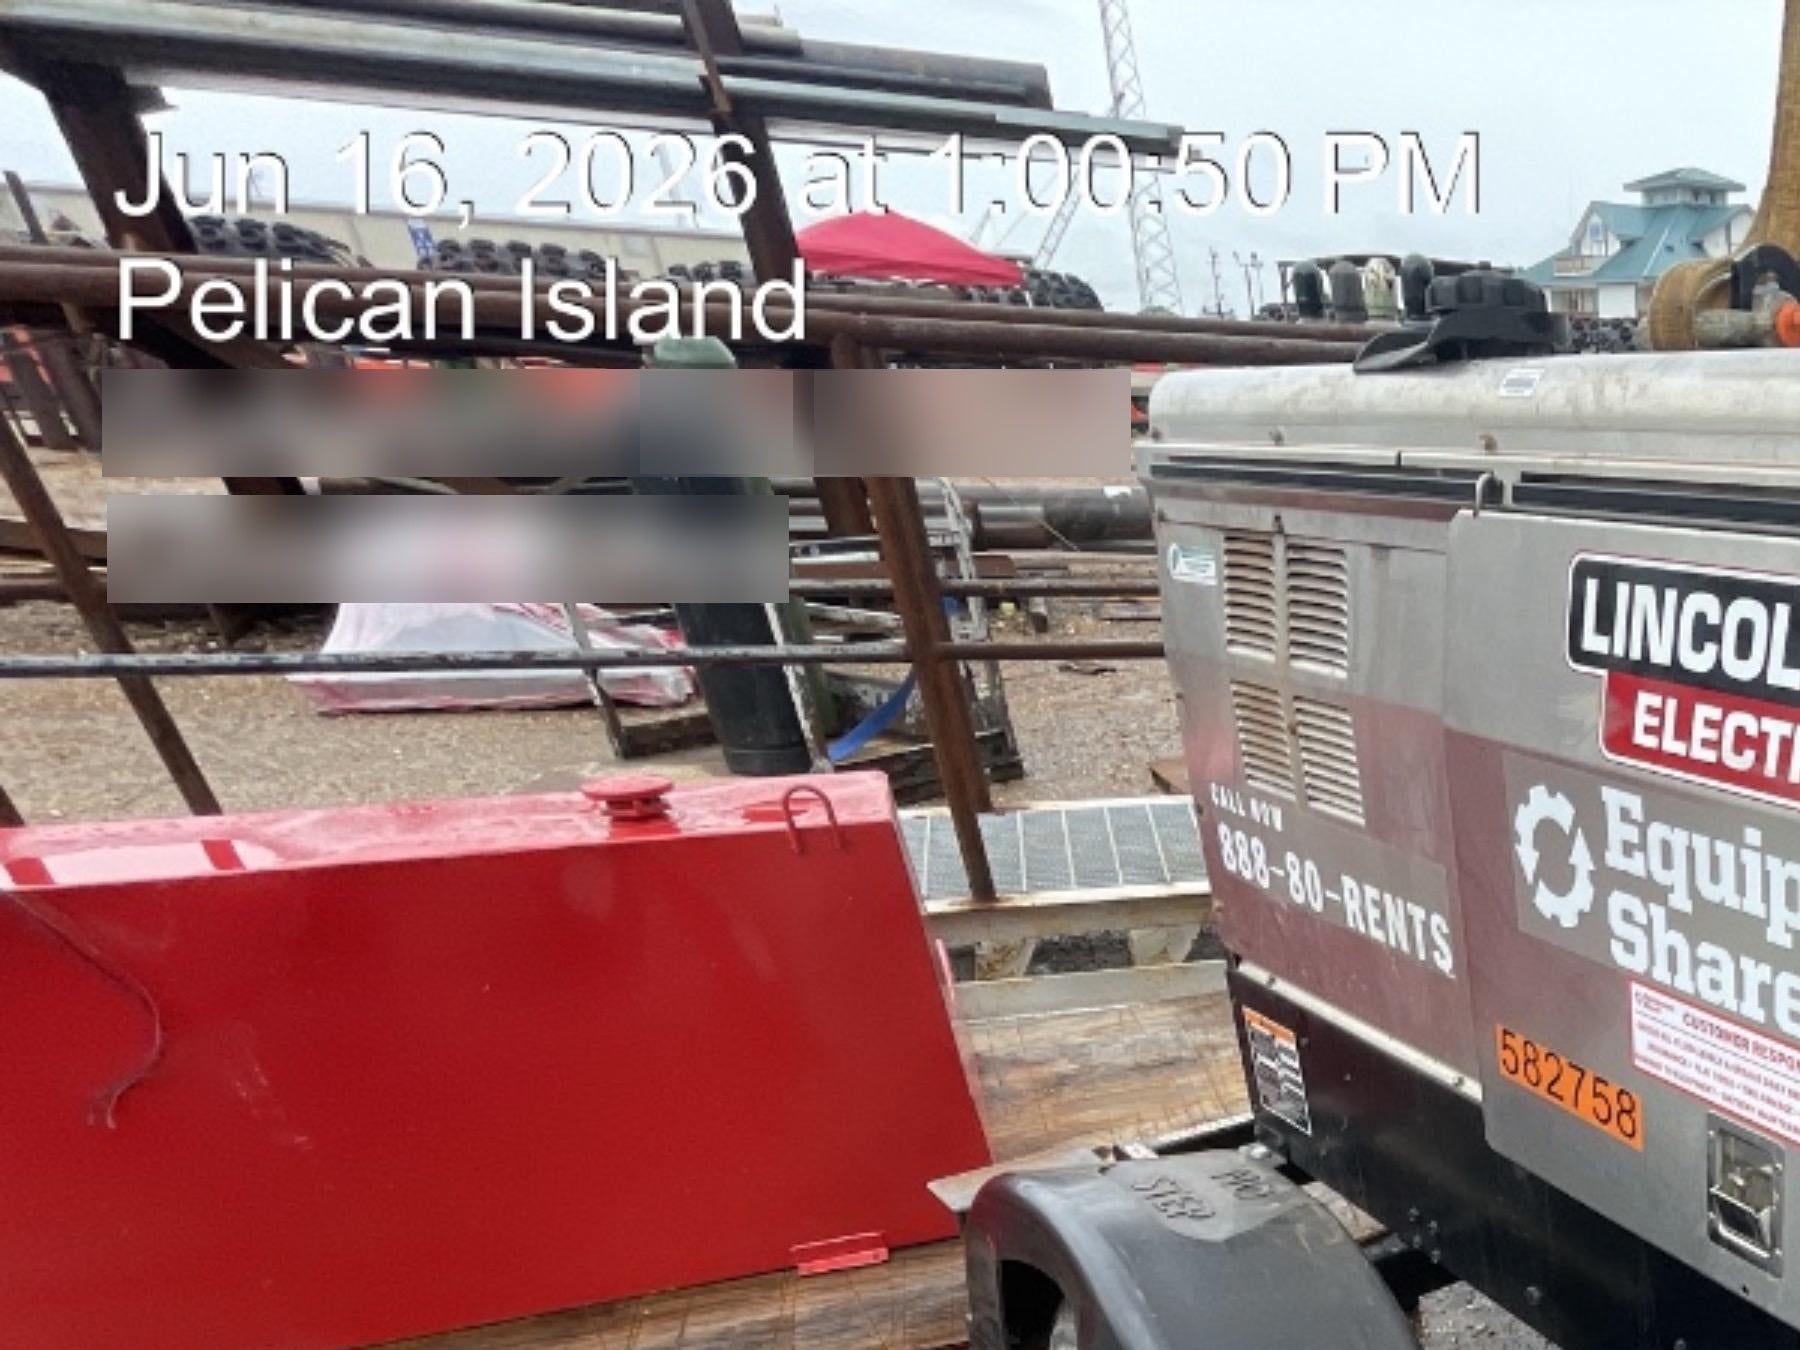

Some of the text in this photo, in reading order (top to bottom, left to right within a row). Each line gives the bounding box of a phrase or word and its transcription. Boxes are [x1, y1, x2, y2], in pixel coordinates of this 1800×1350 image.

[1216, 821, 1456, 976] 888-80-RENTS
[1498, 1028, 1639, 1141] 582758
[1681, 1010, 1751, 1056] CUSTOMER
